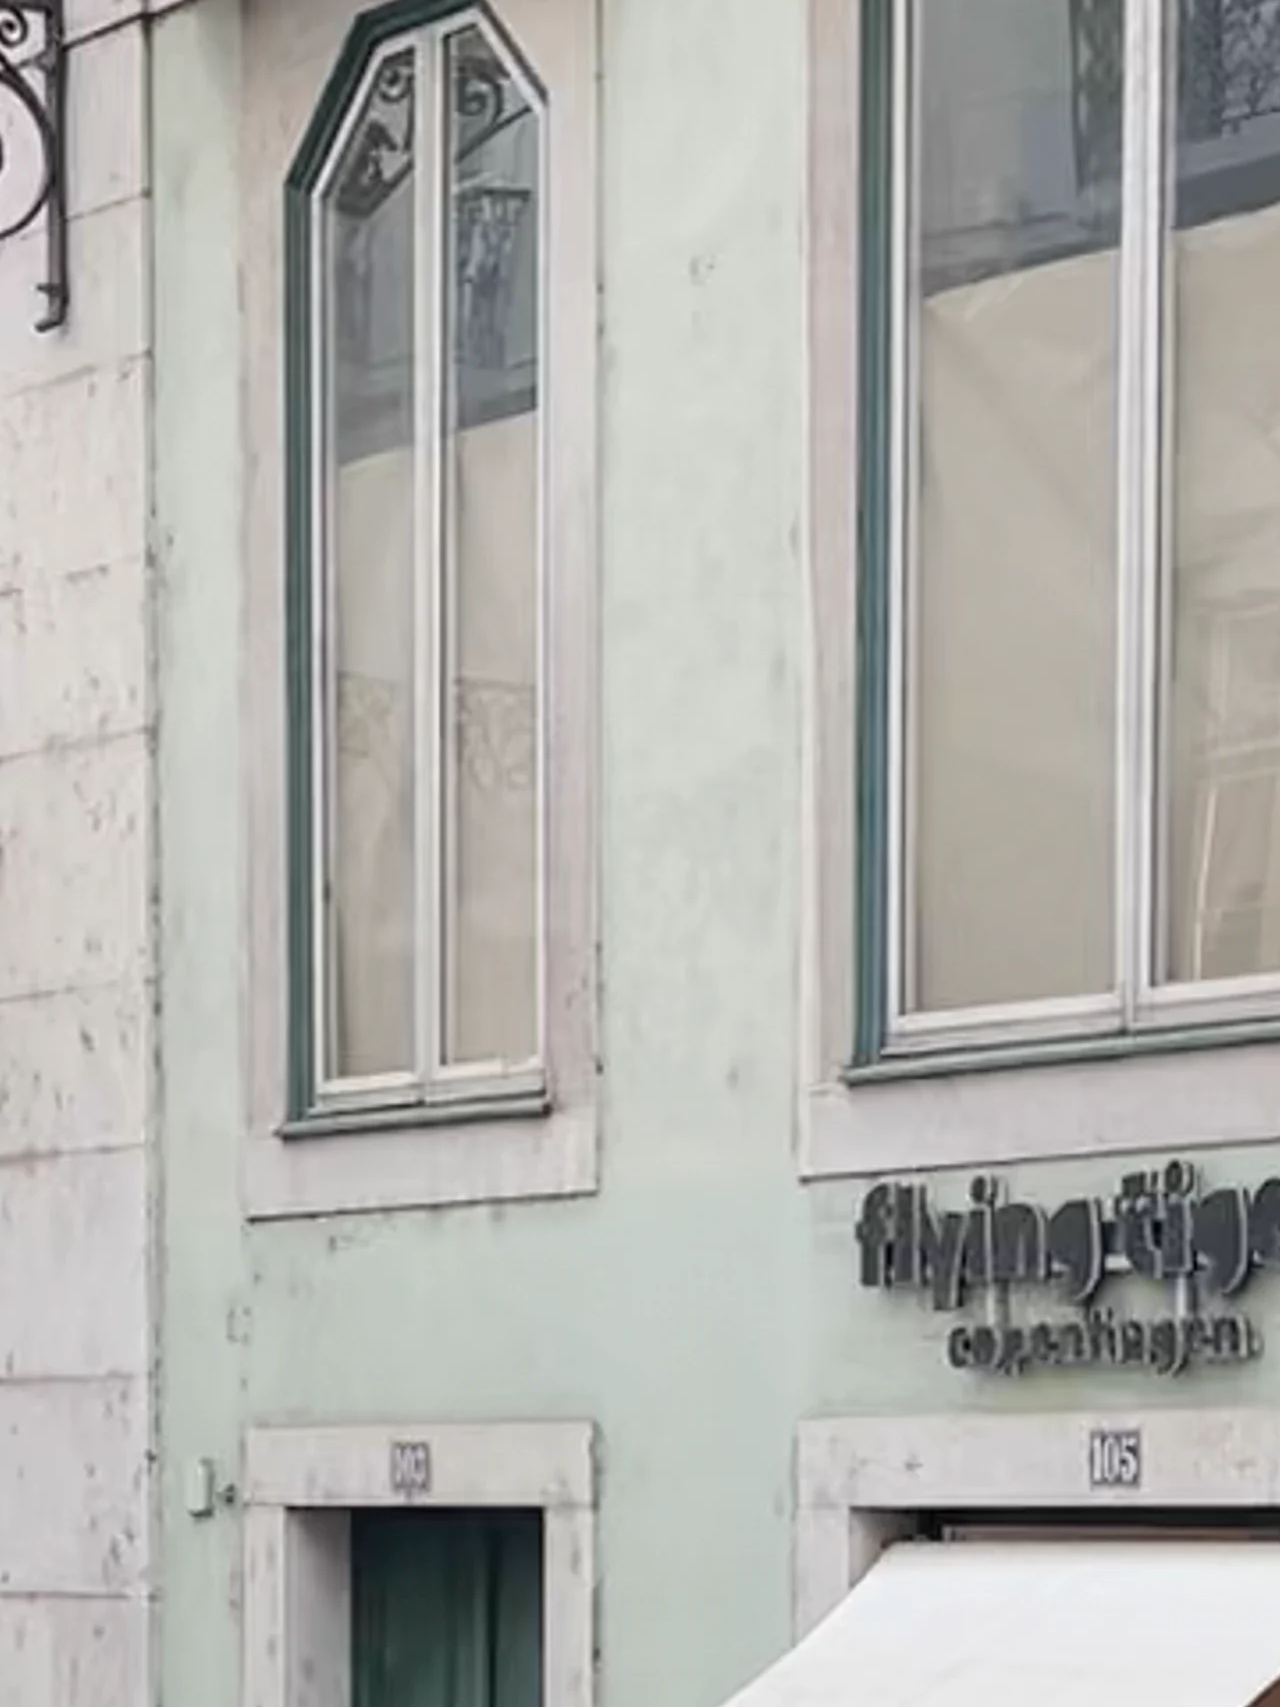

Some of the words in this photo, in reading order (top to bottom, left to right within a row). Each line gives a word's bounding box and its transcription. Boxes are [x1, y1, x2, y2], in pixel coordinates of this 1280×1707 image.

[856, 1177, 1106, 1311] flying
[946, 1311, 1265, 1377] copenhagen
[1093, 1437, 1139, 1482] 105
